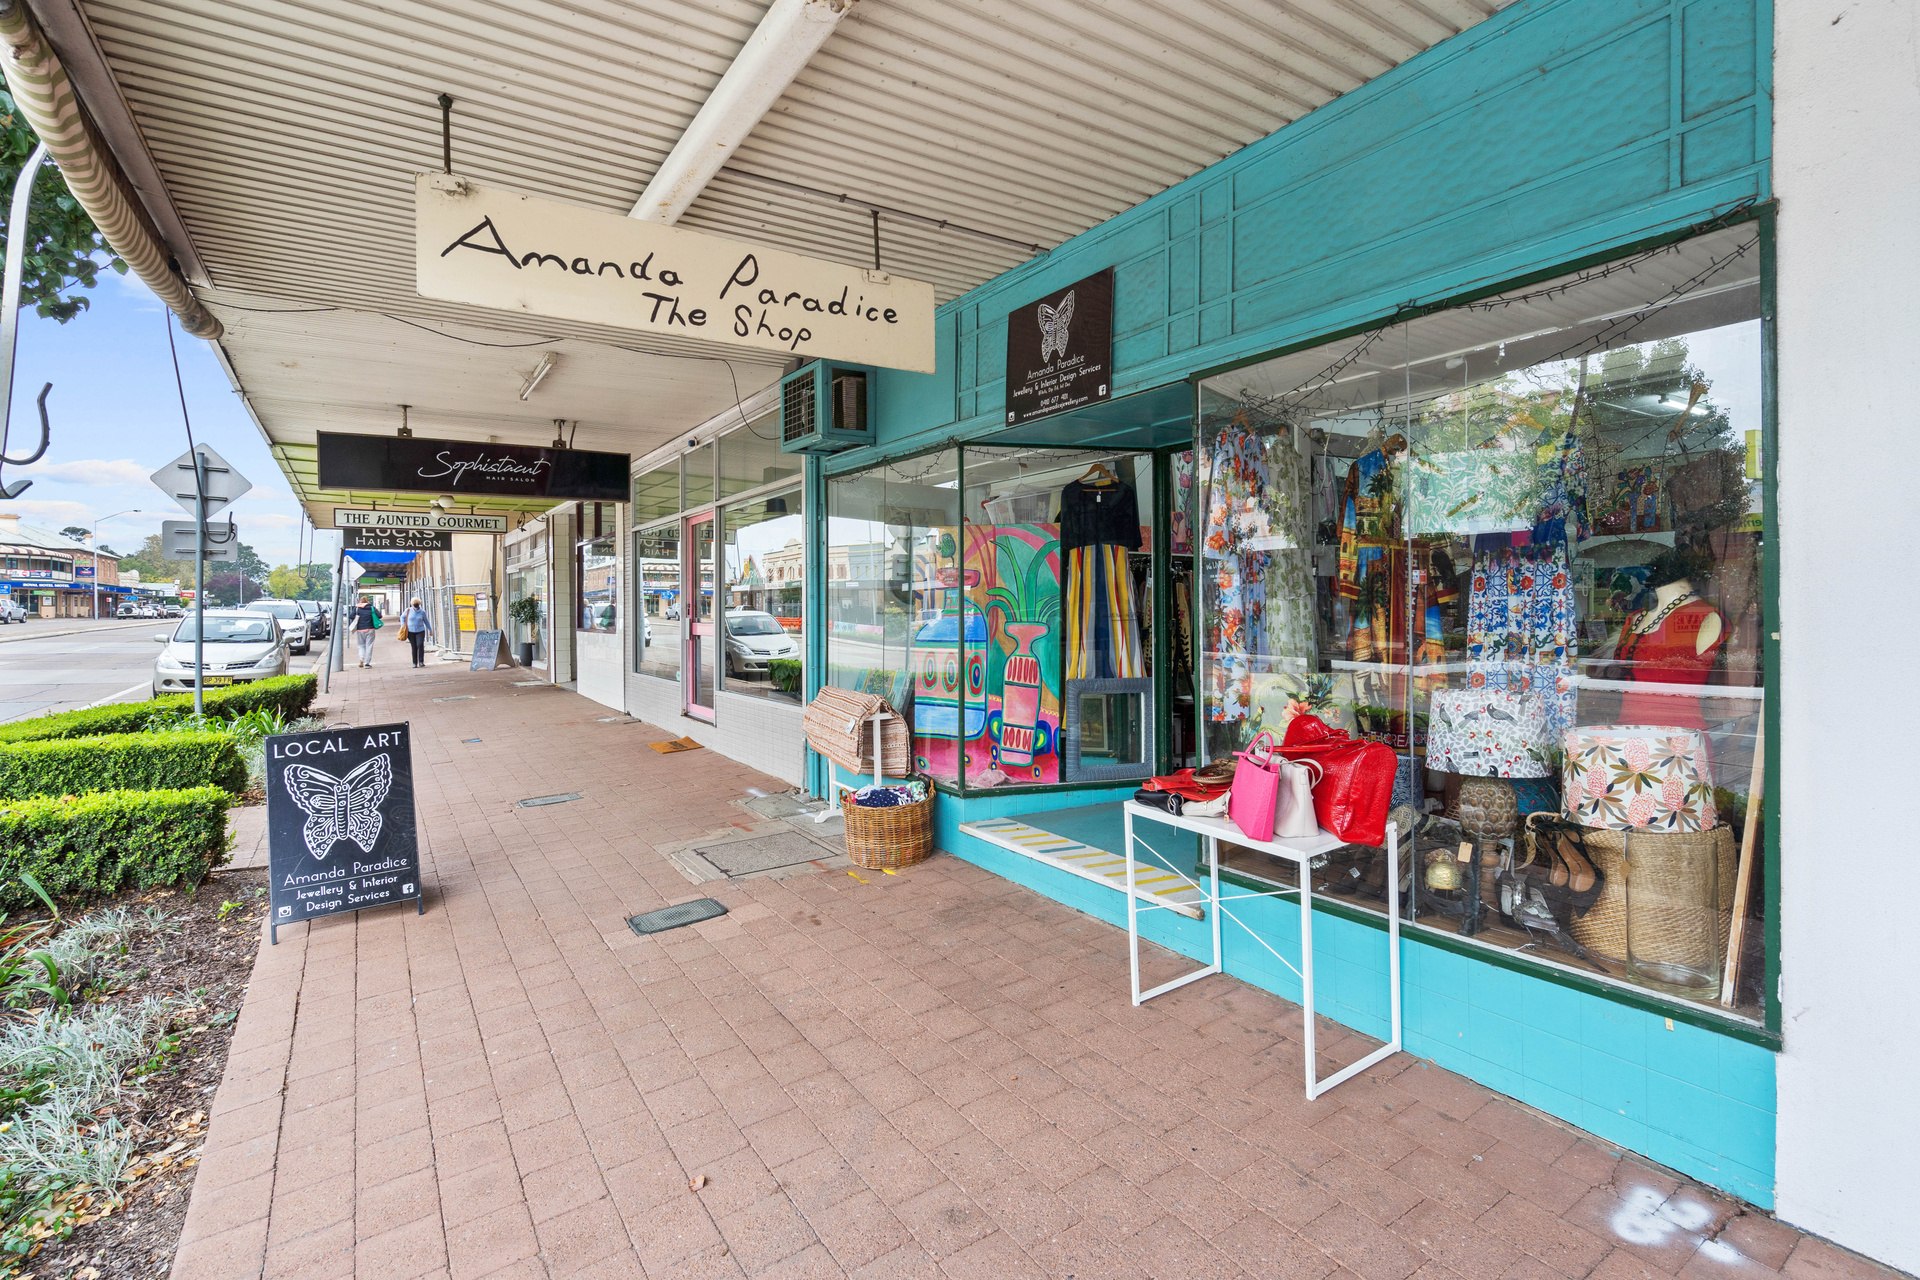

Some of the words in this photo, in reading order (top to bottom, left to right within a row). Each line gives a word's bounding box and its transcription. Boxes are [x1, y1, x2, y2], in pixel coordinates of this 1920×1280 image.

[441, 214, 684, 287] Amanda
[719, 253, 899, 325] Paradice
[641, 291, 708, 328] The
[733, 304, 813, 352] Shop
[1012, 385, 1033, 398] Jewellery
[1040, 378, 1058, 389] Interior
[1059, 371, 1077, 383] Design
[1079, 364, 1102, 377] Services
[1027, 363, 1054, 381] Amanda
[1057, 353, 1085, 370] Paradice
[417, 450, 551, 486] Sophistacut
[344, 513, 370, 524] THE
[437, 516, 500, 529] GOURMET
[273, 737, 350, 759] LOCAL
[363, 731, 402, 749] ART
[283, 865, 345, 887] Amanda
[353, 856, 408, 874] Paradice
[296, 885, 344, 901] Jewellery
[348, 880, 357, 891] &
[362, 875, 398, 888] Interior
[306, 899, 342, 912] Design
[347, 890, 390, 904] Services
